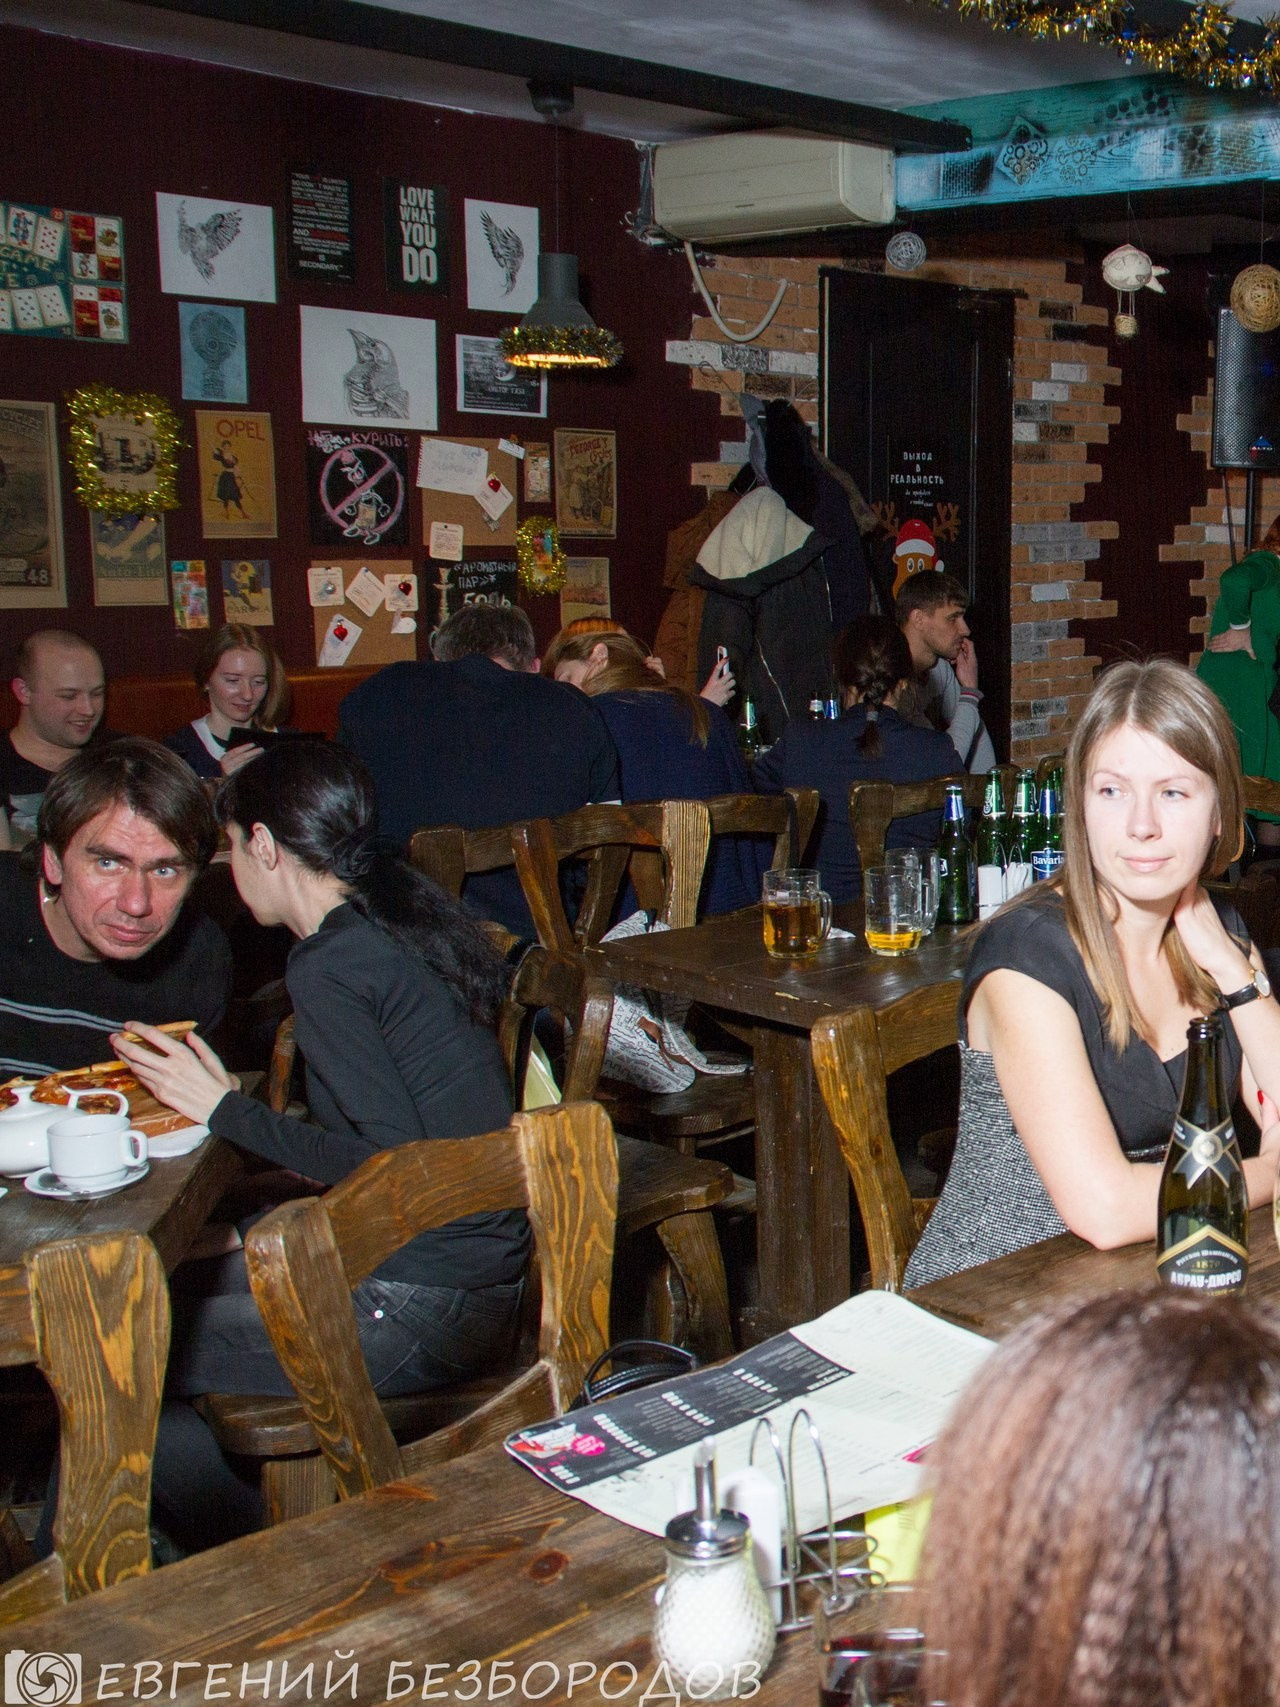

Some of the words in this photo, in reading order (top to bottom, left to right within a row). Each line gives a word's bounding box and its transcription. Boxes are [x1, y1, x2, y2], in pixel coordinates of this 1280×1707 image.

[400, 184, 435, 210] LOVE
[400, 204, 436, 226] WHAT
[292, 220, 314, 228] FOLLOW
[316, 223, 331, 231] YOUR
[332, 225, 349, 233] HEART
[292, 228, 310, 237] AND
[400, 220, 436, 249] YOU
[300, 245, 330, 254] EVERYTHING
[402, 244, 438, 285] DO
[216, 419, 266, 441] OPEL
[903, 451, 932, 461] ВЫХОД
[916, 463, 921, 472] В
[890, 474, 944, 485] РЕАЛЬНОСТЬ
[27, 568, 49, 586] 48
